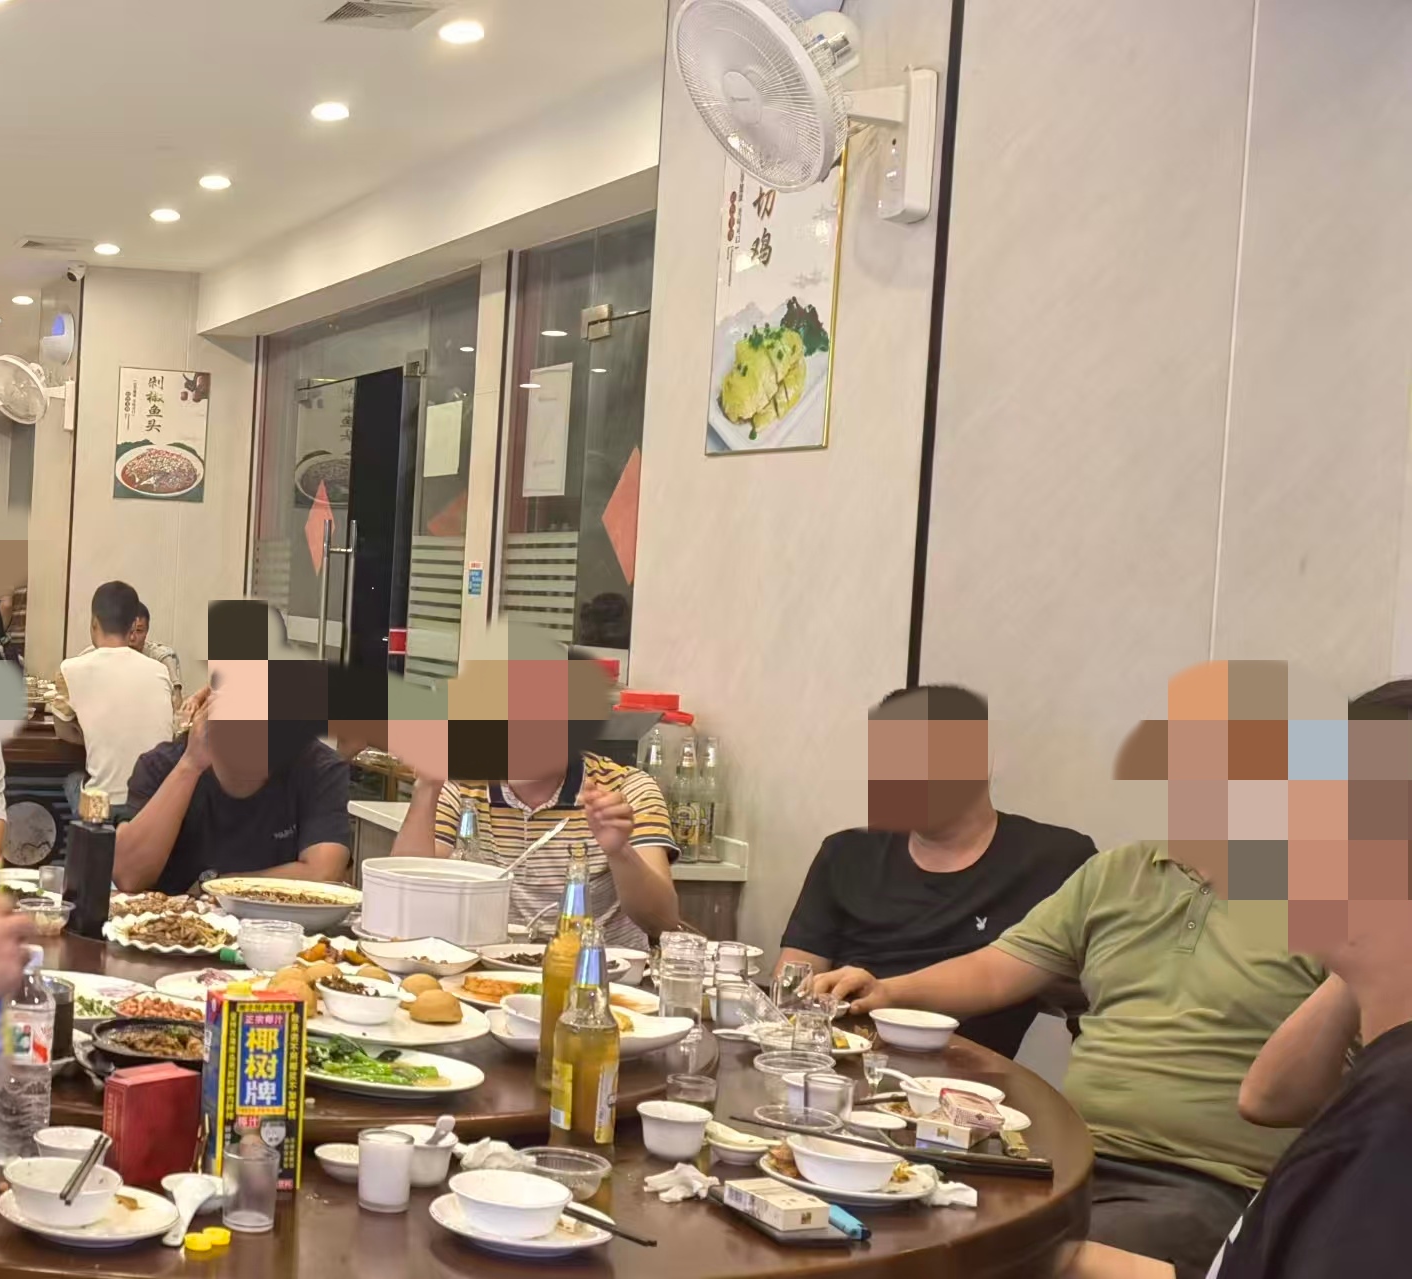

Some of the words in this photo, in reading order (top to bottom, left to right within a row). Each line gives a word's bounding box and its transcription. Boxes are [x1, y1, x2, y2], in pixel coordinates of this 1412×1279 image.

[145, 375, 165, 433] 剁椒鱼头
[245, 1028, 279, 1105] 椰树牌
